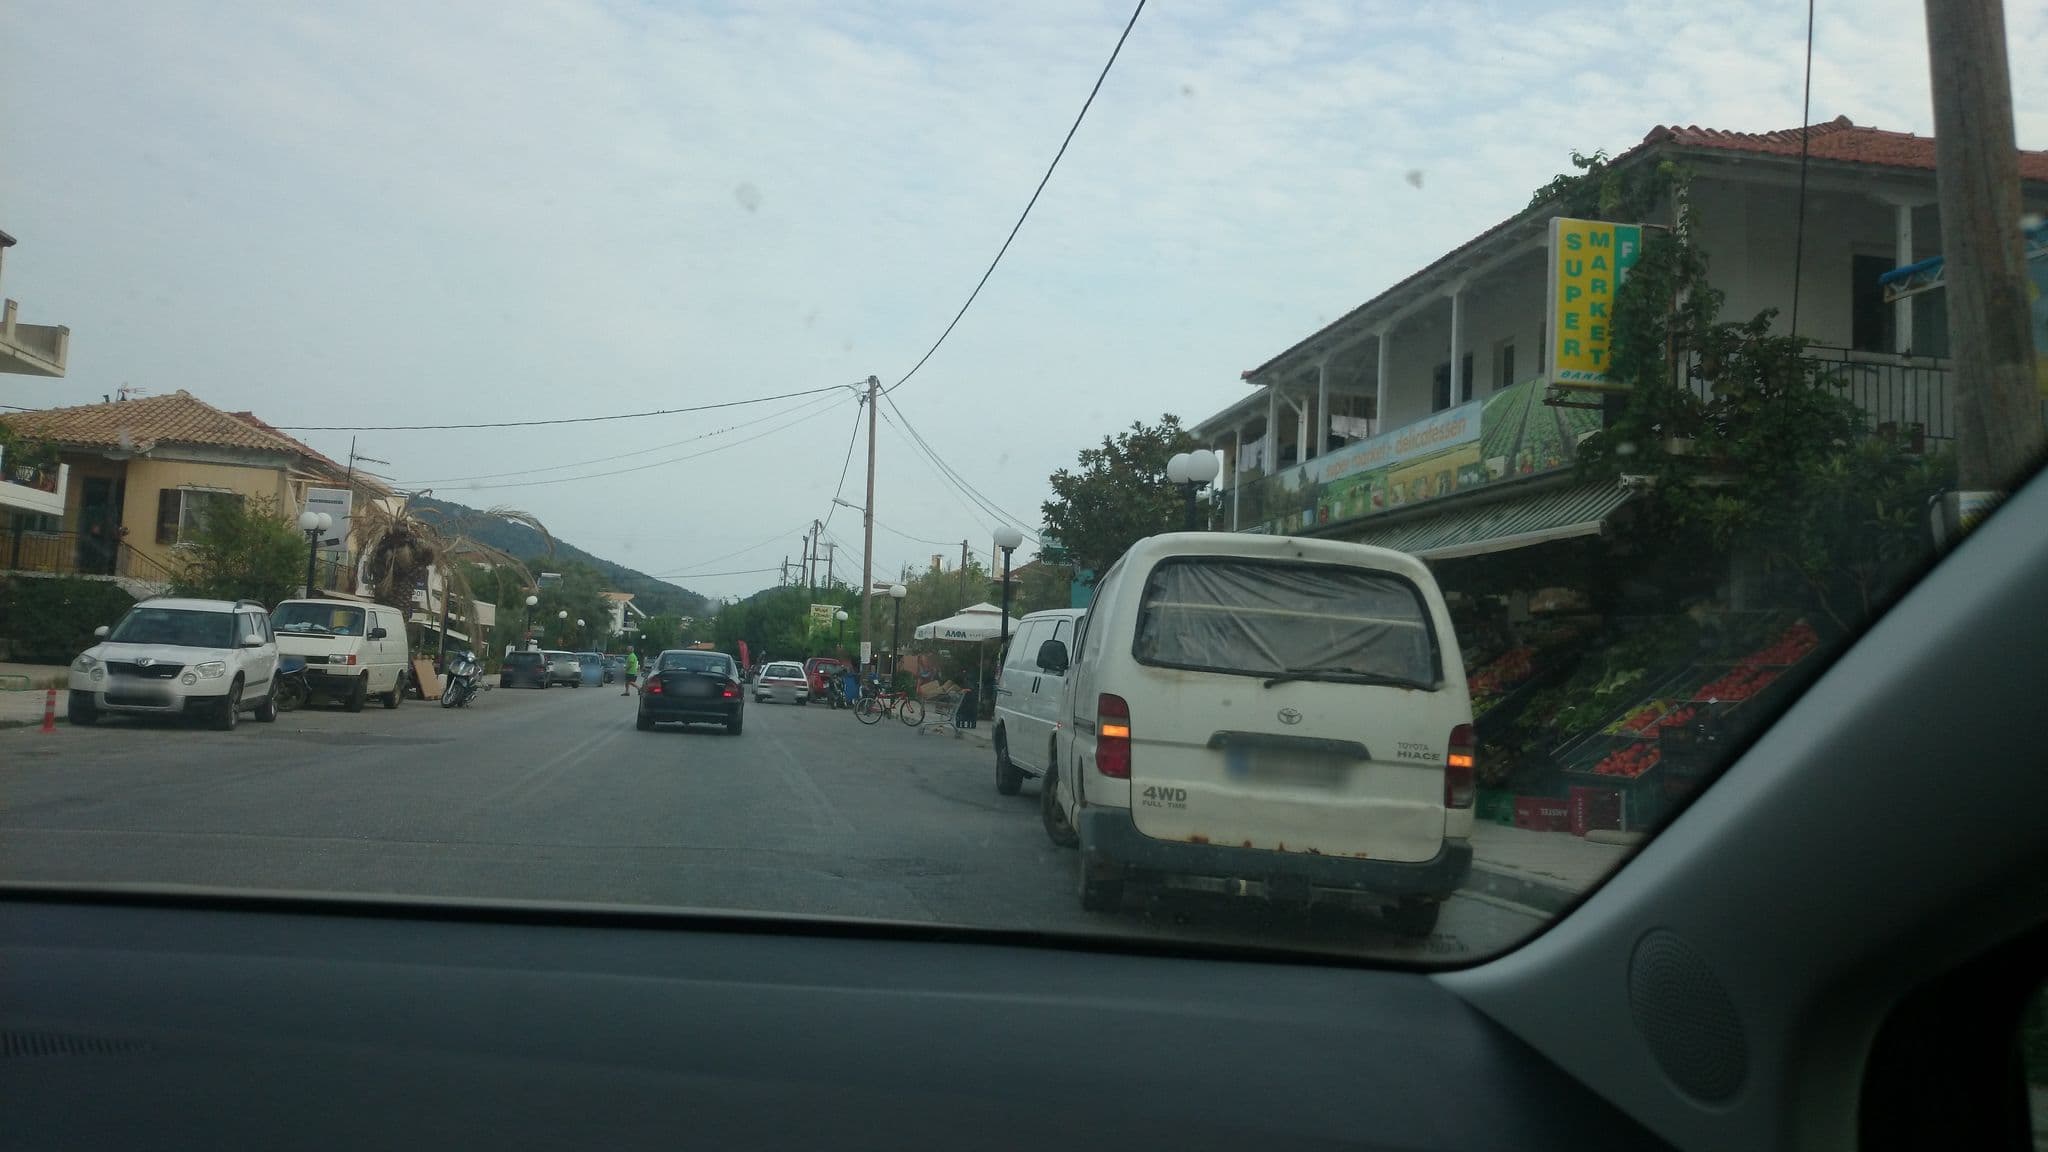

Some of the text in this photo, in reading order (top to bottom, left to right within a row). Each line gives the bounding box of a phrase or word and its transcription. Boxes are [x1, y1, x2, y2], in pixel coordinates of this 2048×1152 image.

[1564, 232, 1583, 358] SUPER
[1589, 231, 1610, 366] MARKET
[1395, 416, 1467, 454] delicatessen
[1397, 741, 1430, 752] TOYOTA
[1397, 750, 1441, 761] HIACE
[1143, 785, 1188, 802] 4WD
[1142, 800, 1162, 808] FULL
